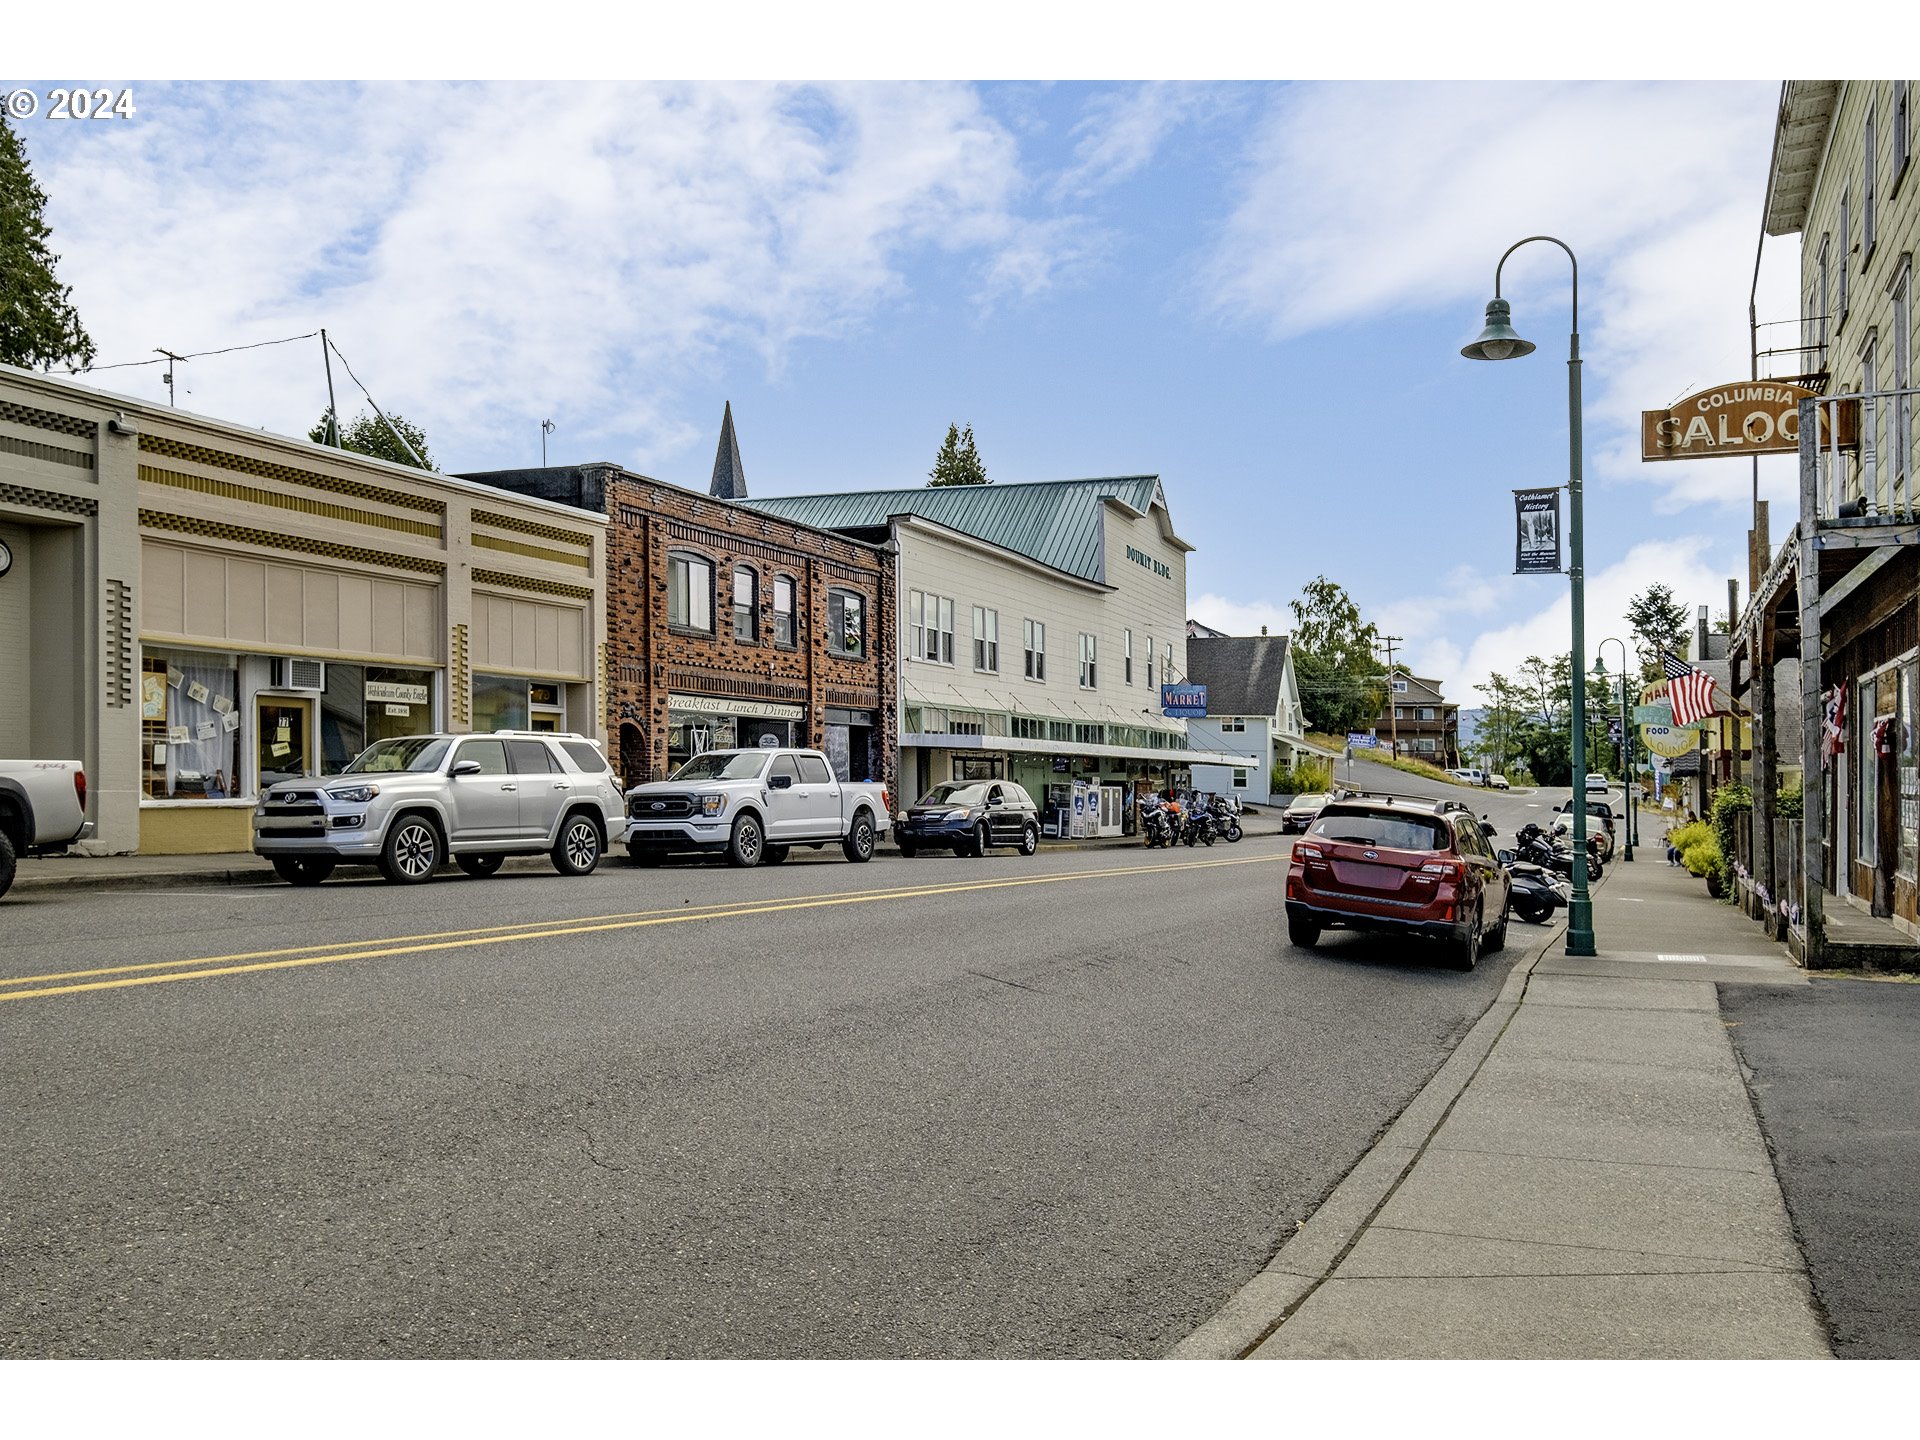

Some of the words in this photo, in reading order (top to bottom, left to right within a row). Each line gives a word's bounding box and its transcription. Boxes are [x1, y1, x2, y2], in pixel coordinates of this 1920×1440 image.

[1697, 387, 1794, 412] COLUMBIA
[1519, 492, 1553, 502] Cathlamet
[395, 687, 412, 700] County
[412, 689, 427, 701] Eagle
[538, 689, 550, 700] 79
[1165, 691, 1205, 705] MARKET
[667, 696, 721, 713] Breakfast
[726, 702, 759, 714] Lunch
[763, 704, 802, 718] Dinner
[1175, 709, 1204, 717] LIQUOR
[1649, 737, 1695, 755] LOUNGE
